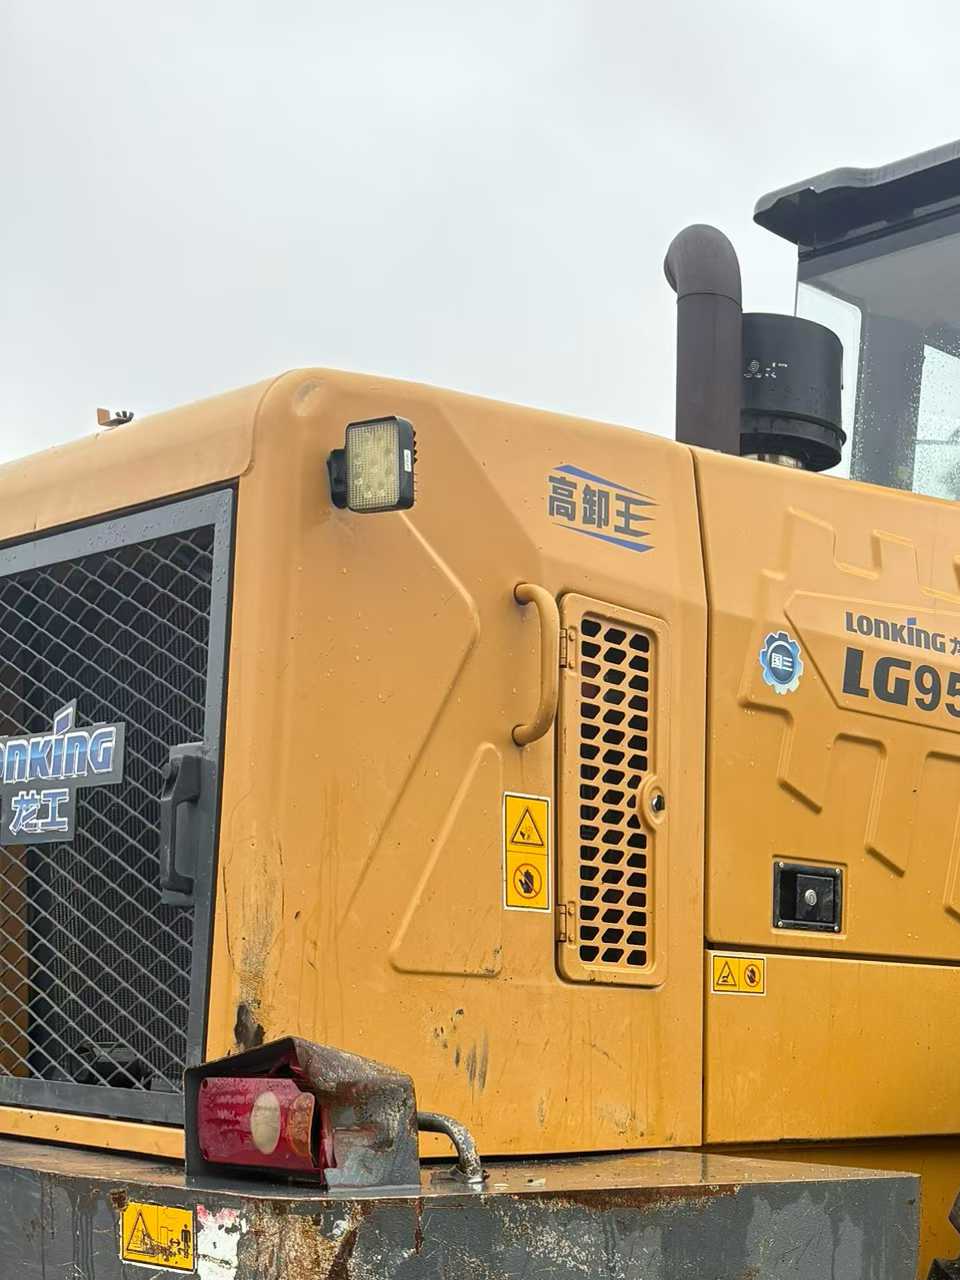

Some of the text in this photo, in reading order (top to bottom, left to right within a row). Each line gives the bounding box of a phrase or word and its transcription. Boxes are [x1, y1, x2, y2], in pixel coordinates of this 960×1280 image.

[548, 475, 660, 538] 高卸王
[9, 788, 70, 835] 龙工
